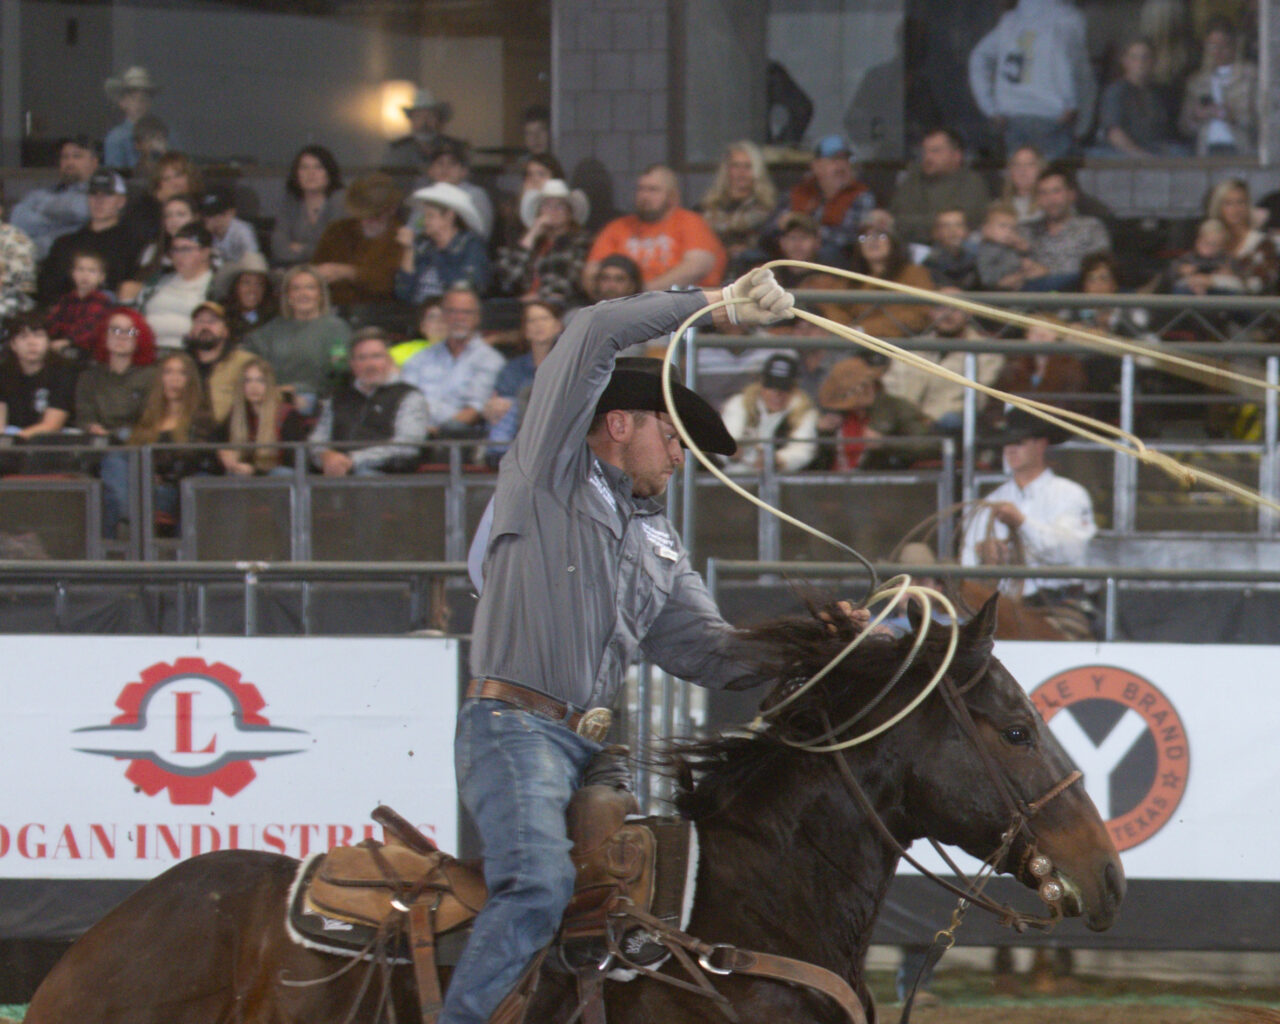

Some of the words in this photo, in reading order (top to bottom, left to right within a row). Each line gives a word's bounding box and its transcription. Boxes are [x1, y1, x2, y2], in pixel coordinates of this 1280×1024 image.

[172, 692, 217, 754] L
[1122, 682, 1184, 761] BRAND
[135, 823, 438, 859] INDUSTRS
[1112, 797, 1169, 841] TEXAS
